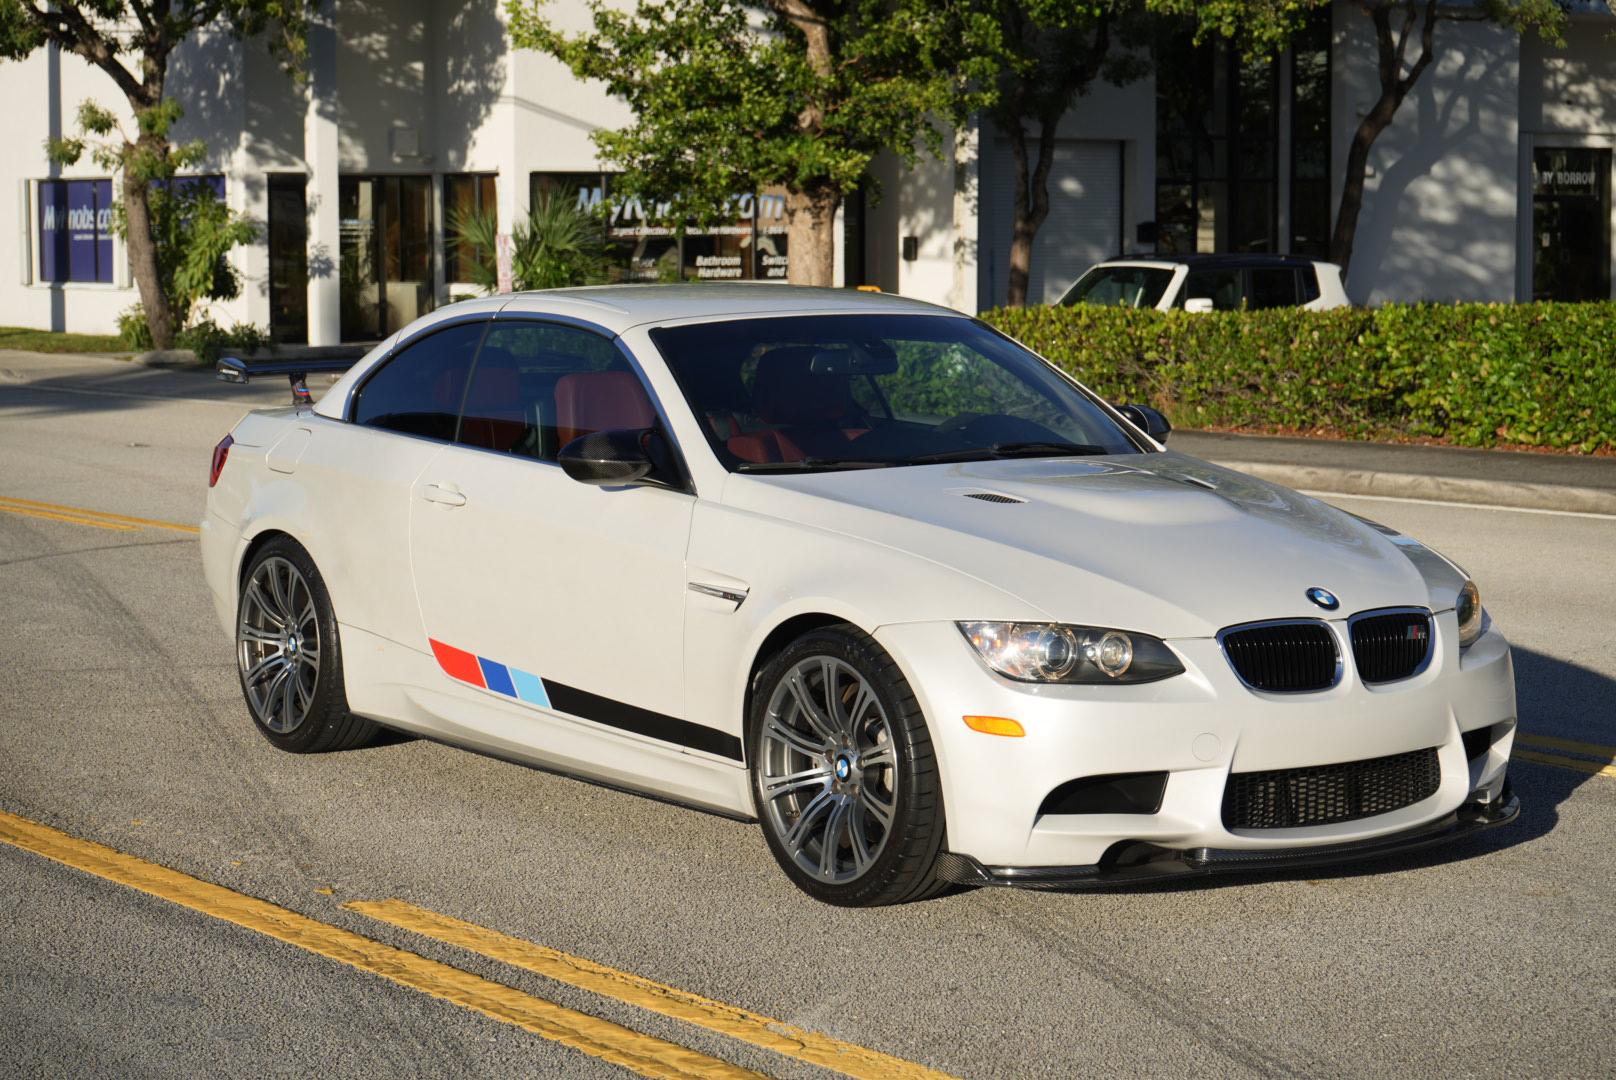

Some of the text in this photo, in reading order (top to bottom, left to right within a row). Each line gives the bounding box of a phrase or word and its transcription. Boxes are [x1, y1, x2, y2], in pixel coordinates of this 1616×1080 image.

[1557, 171, 1596, 185] BORROW
[696, 255, 742, 267] Bathroom
[697, 266, 743, 279] Hardware
[767, 266, 786, 277] and
